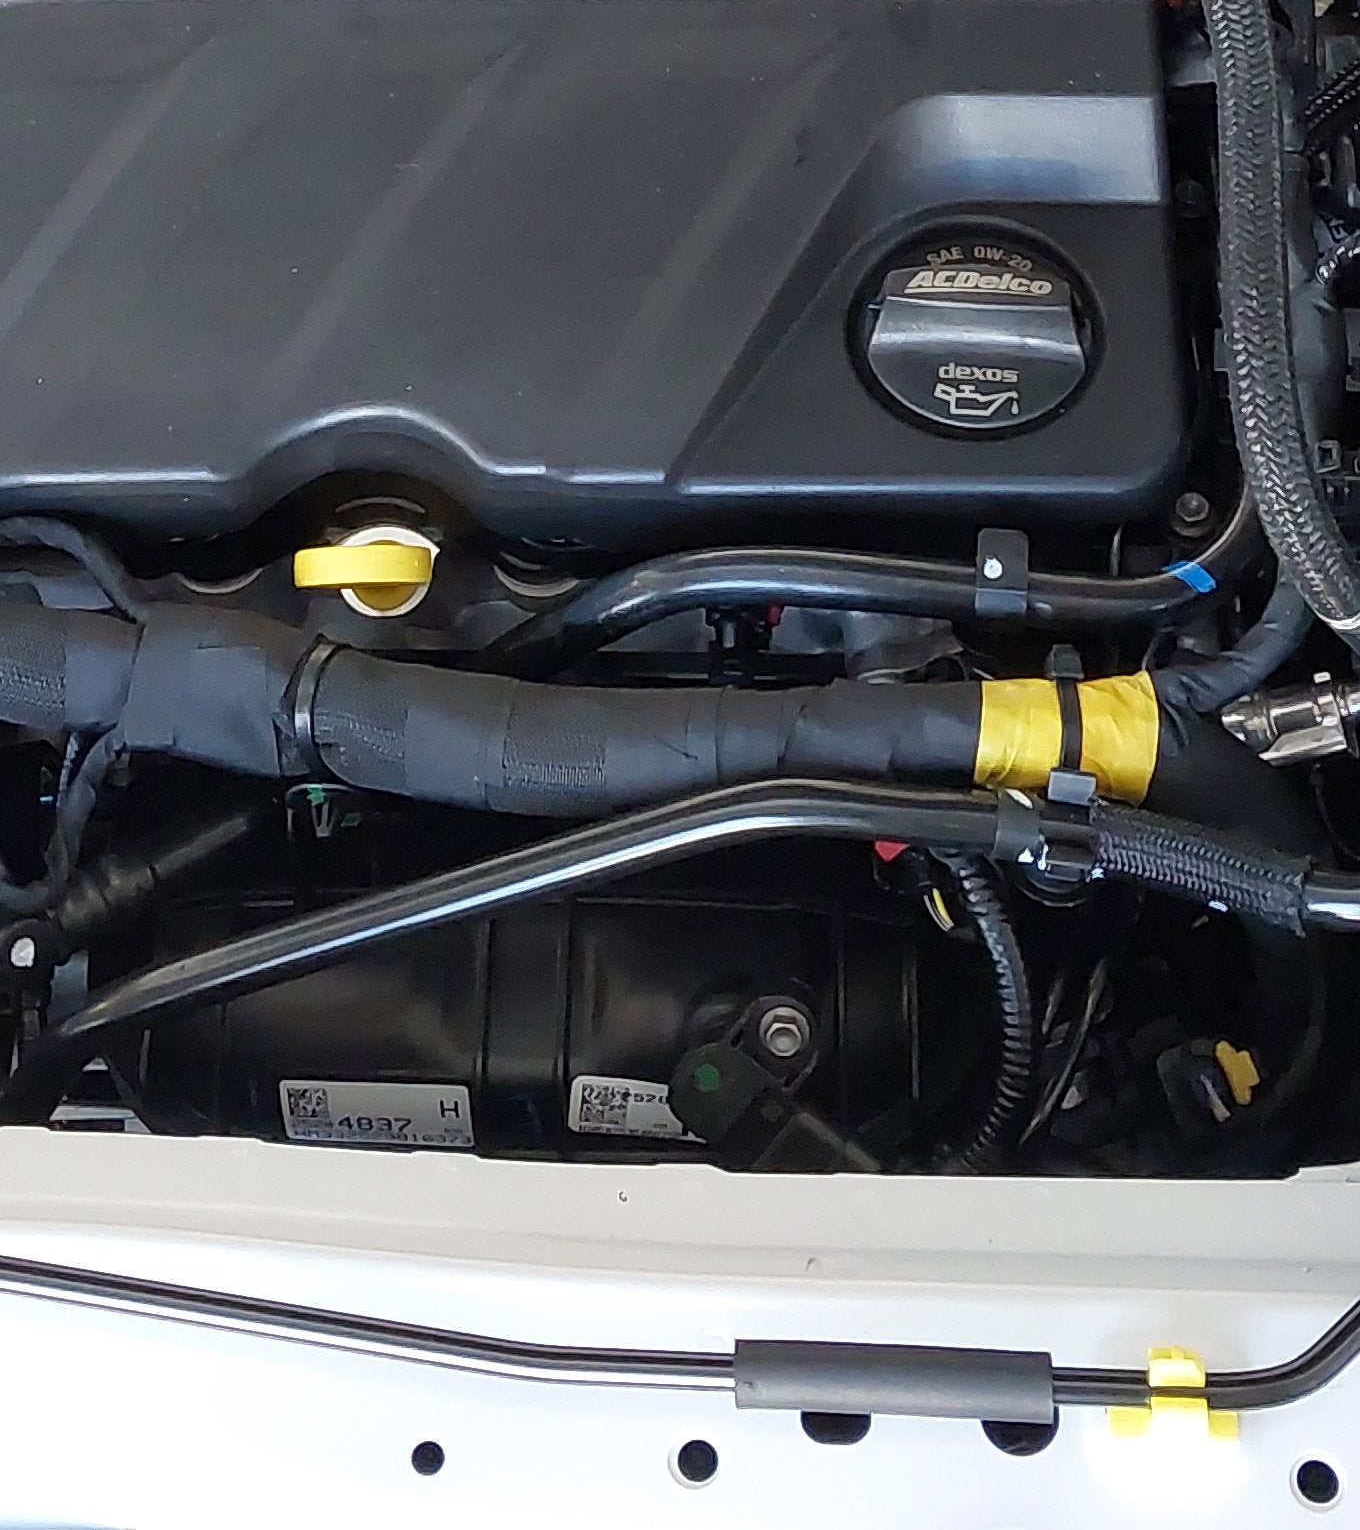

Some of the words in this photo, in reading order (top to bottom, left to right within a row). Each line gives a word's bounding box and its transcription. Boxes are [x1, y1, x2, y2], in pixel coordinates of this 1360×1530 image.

[926, 246, 964, 268] SAE
[973, 245, 1033, 272] 0W-20
[907, 270, 1054, 296] ACDelco
[937, 362, 1020, 384] dexos
[439, 1099, 461, 1119] H
